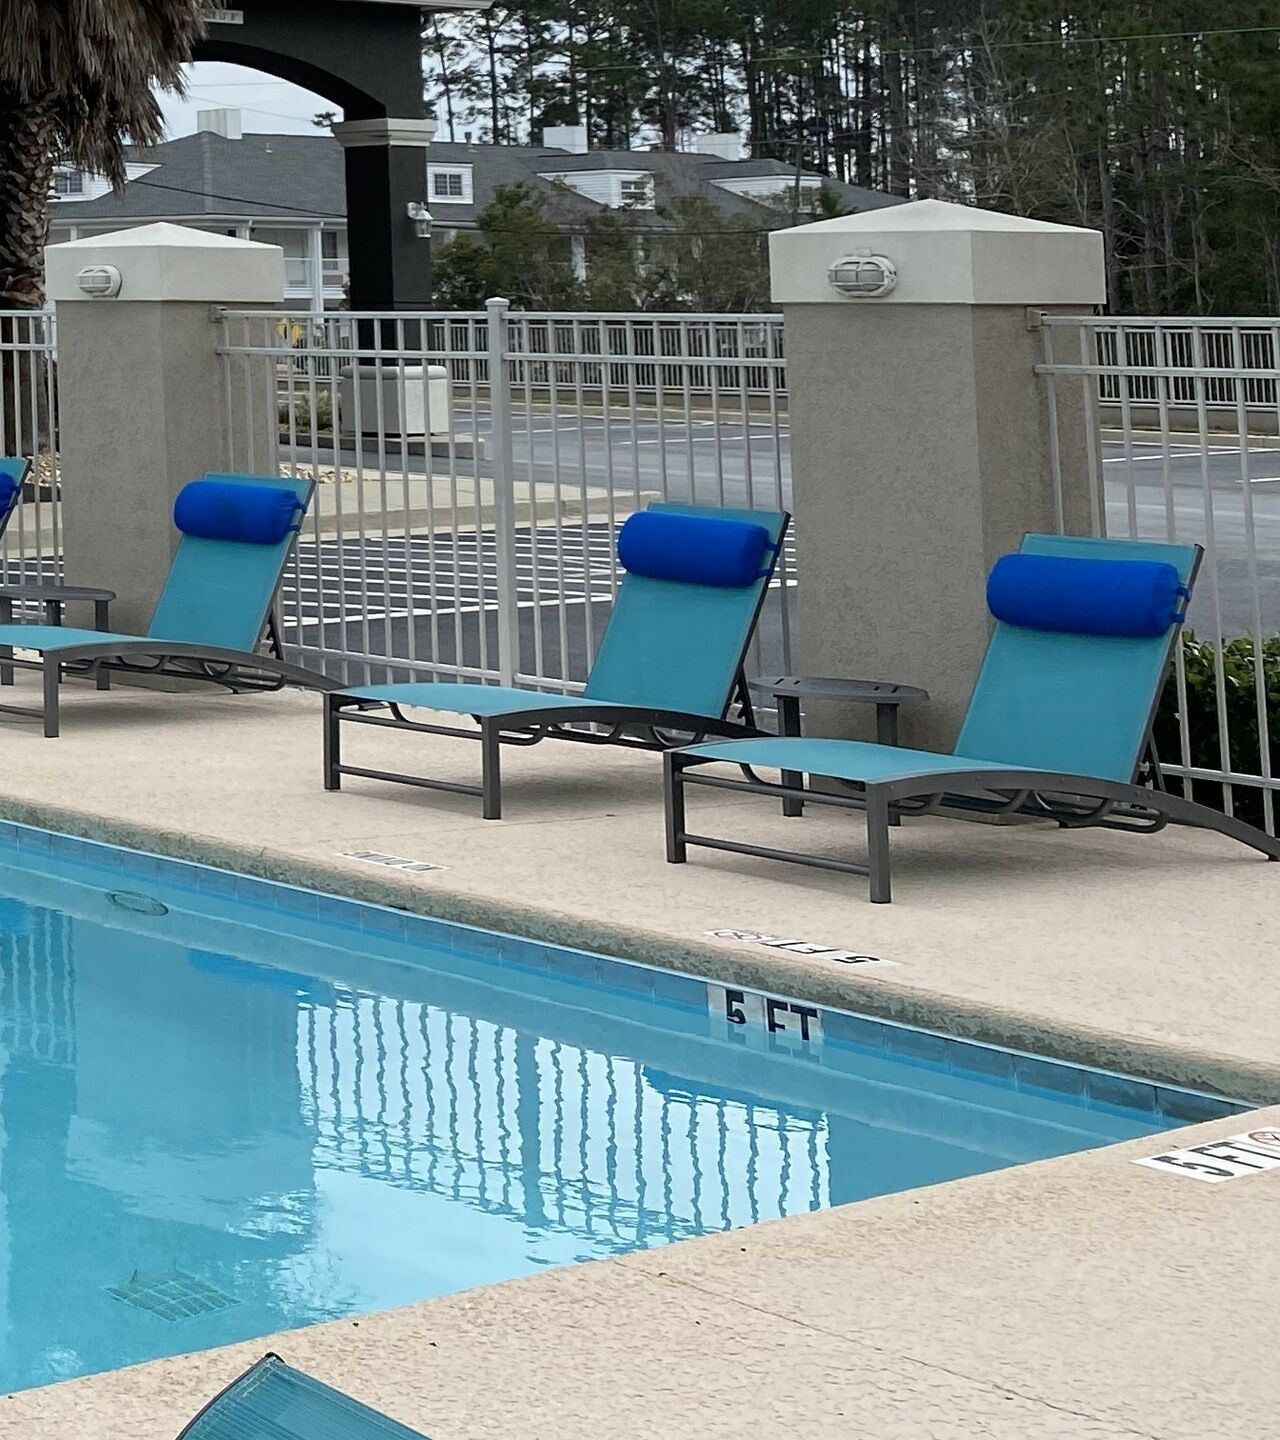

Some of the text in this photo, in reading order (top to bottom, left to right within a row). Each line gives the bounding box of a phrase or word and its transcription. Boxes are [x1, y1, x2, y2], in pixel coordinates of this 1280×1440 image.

[725, 988, 819, 1041] 5 FT
[1151, 1141, 1280, 1177] 5 FT
